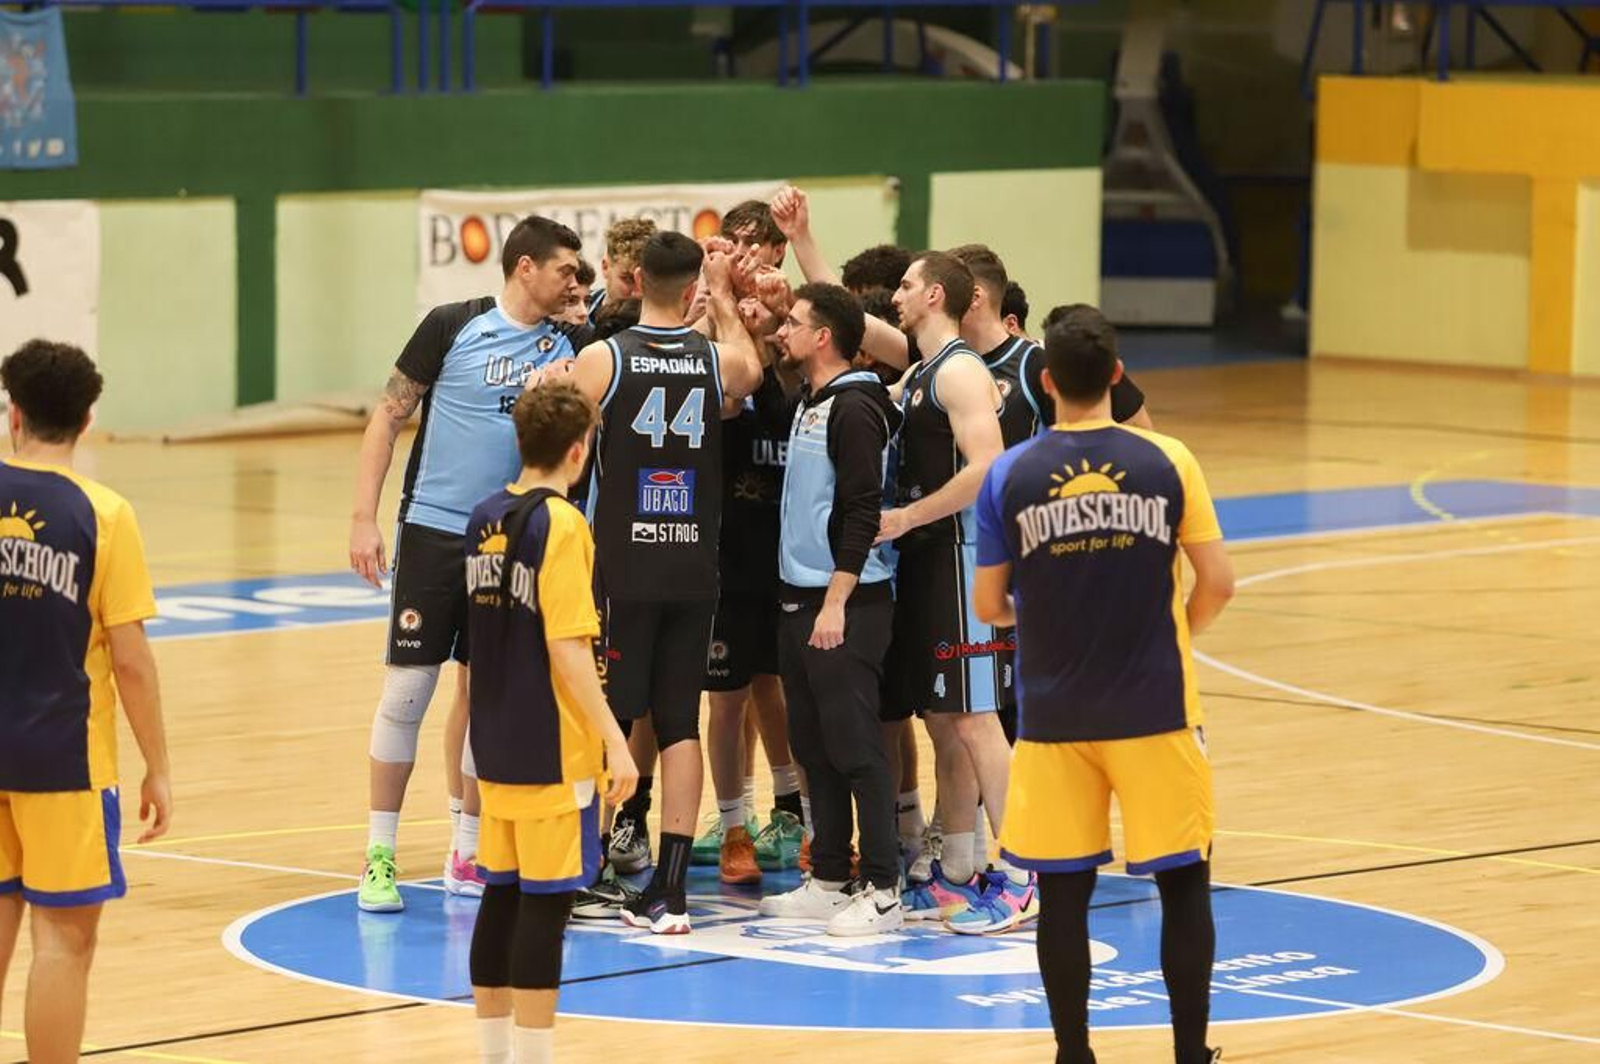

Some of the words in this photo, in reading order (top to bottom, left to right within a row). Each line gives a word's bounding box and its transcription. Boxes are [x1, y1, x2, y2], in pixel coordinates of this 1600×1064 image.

[630, 354, 707, 375] ESPADIÑA
[630, 387, 706, 449] 44
[643, 489, 688, 512] UBAGO
[658, 523, 699, 543] STROG
[1016, 493, 1171, 558] NOVASCHOOL
[1050, 540, 1086, 557] sport
[1089, 537, 1109, 552] for
[1112, 534, 1135, 549] life
[3, 581, 18, 597] for
[21, 583, 43, 599] life
[396, 639, 422, 649] vive
[933, 672, 946, 698] 4
